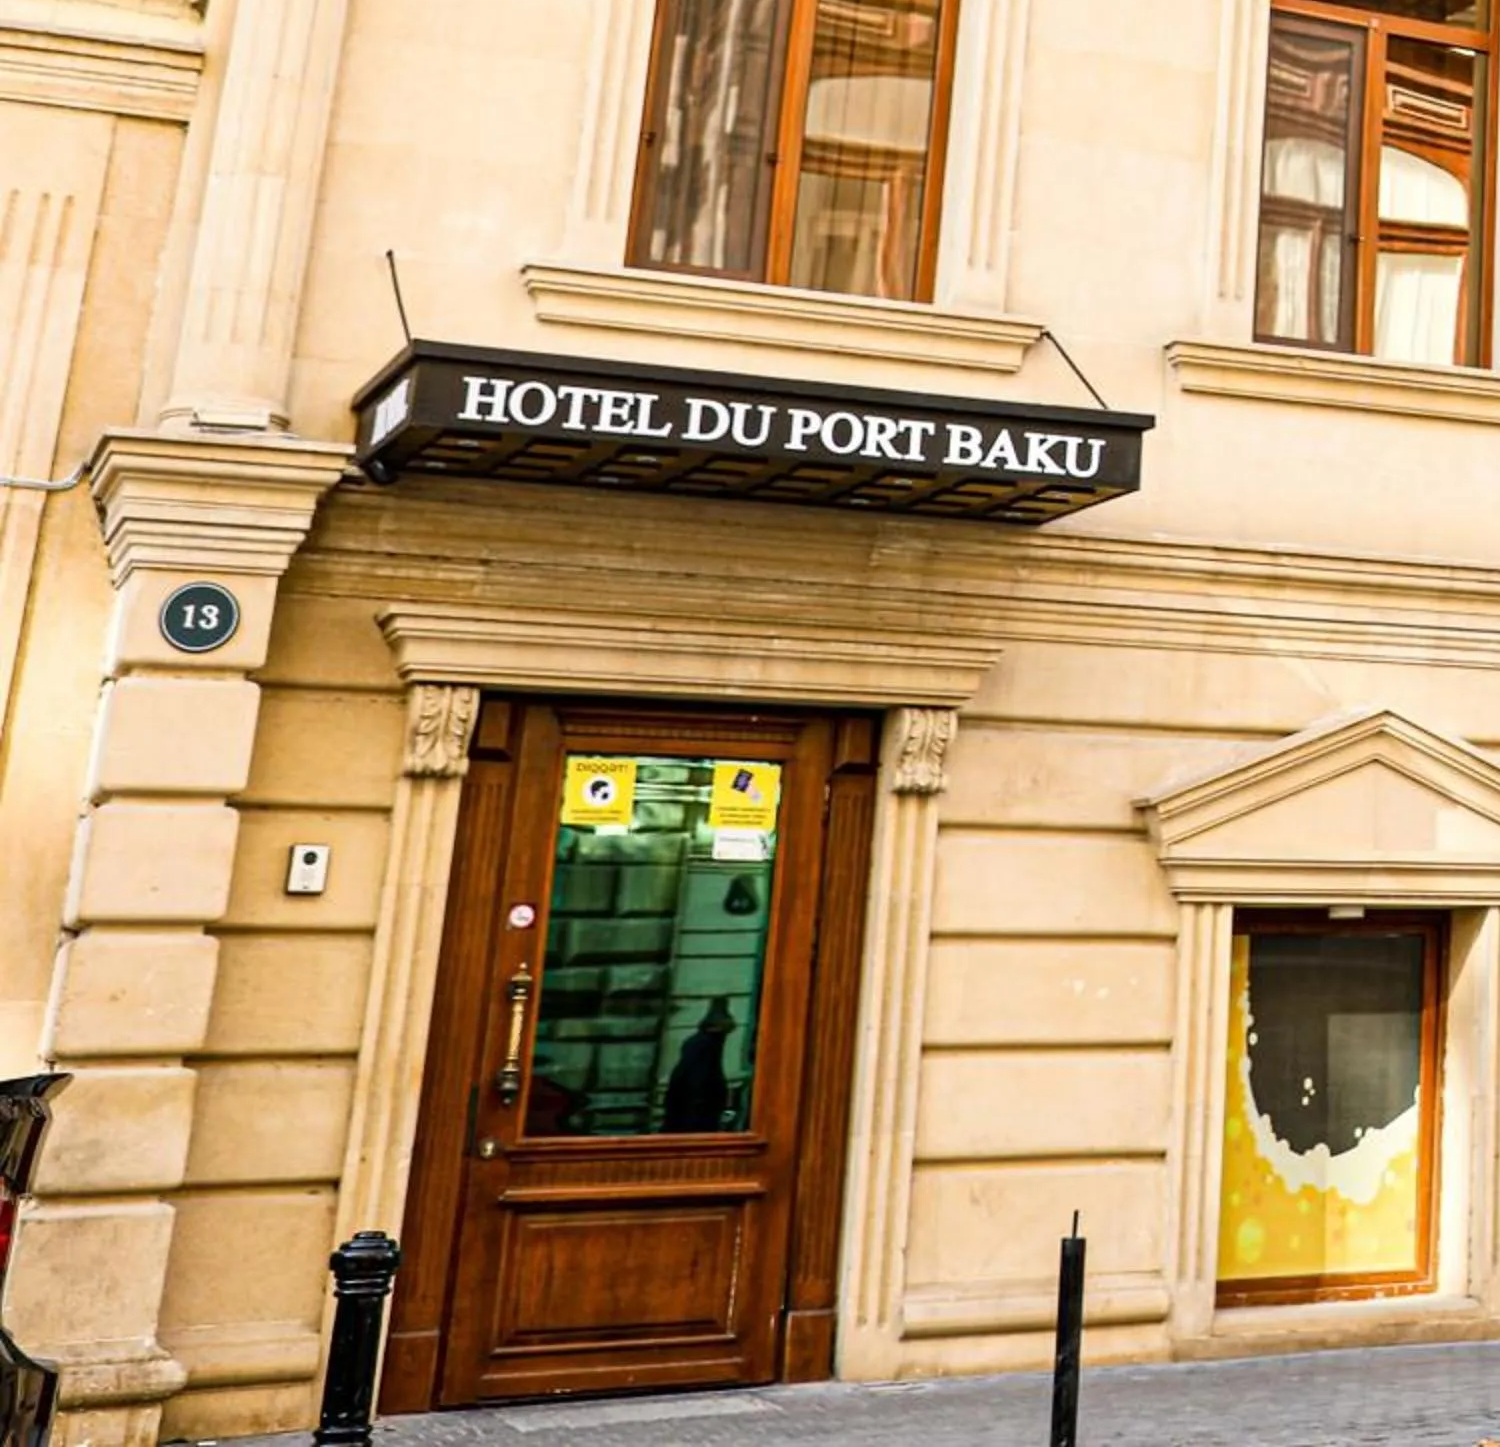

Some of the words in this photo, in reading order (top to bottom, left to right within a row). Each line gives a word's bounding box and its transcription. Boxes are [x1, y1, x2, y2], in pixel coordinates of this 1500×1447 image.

[457, 376, 671, 437] HOTEL
[681, 397, 776, 447] DU
[784, 408, 935, 462] PORT
[943, 424, 1107, 478] BAKU
[182, 604, 220, 630] 13
